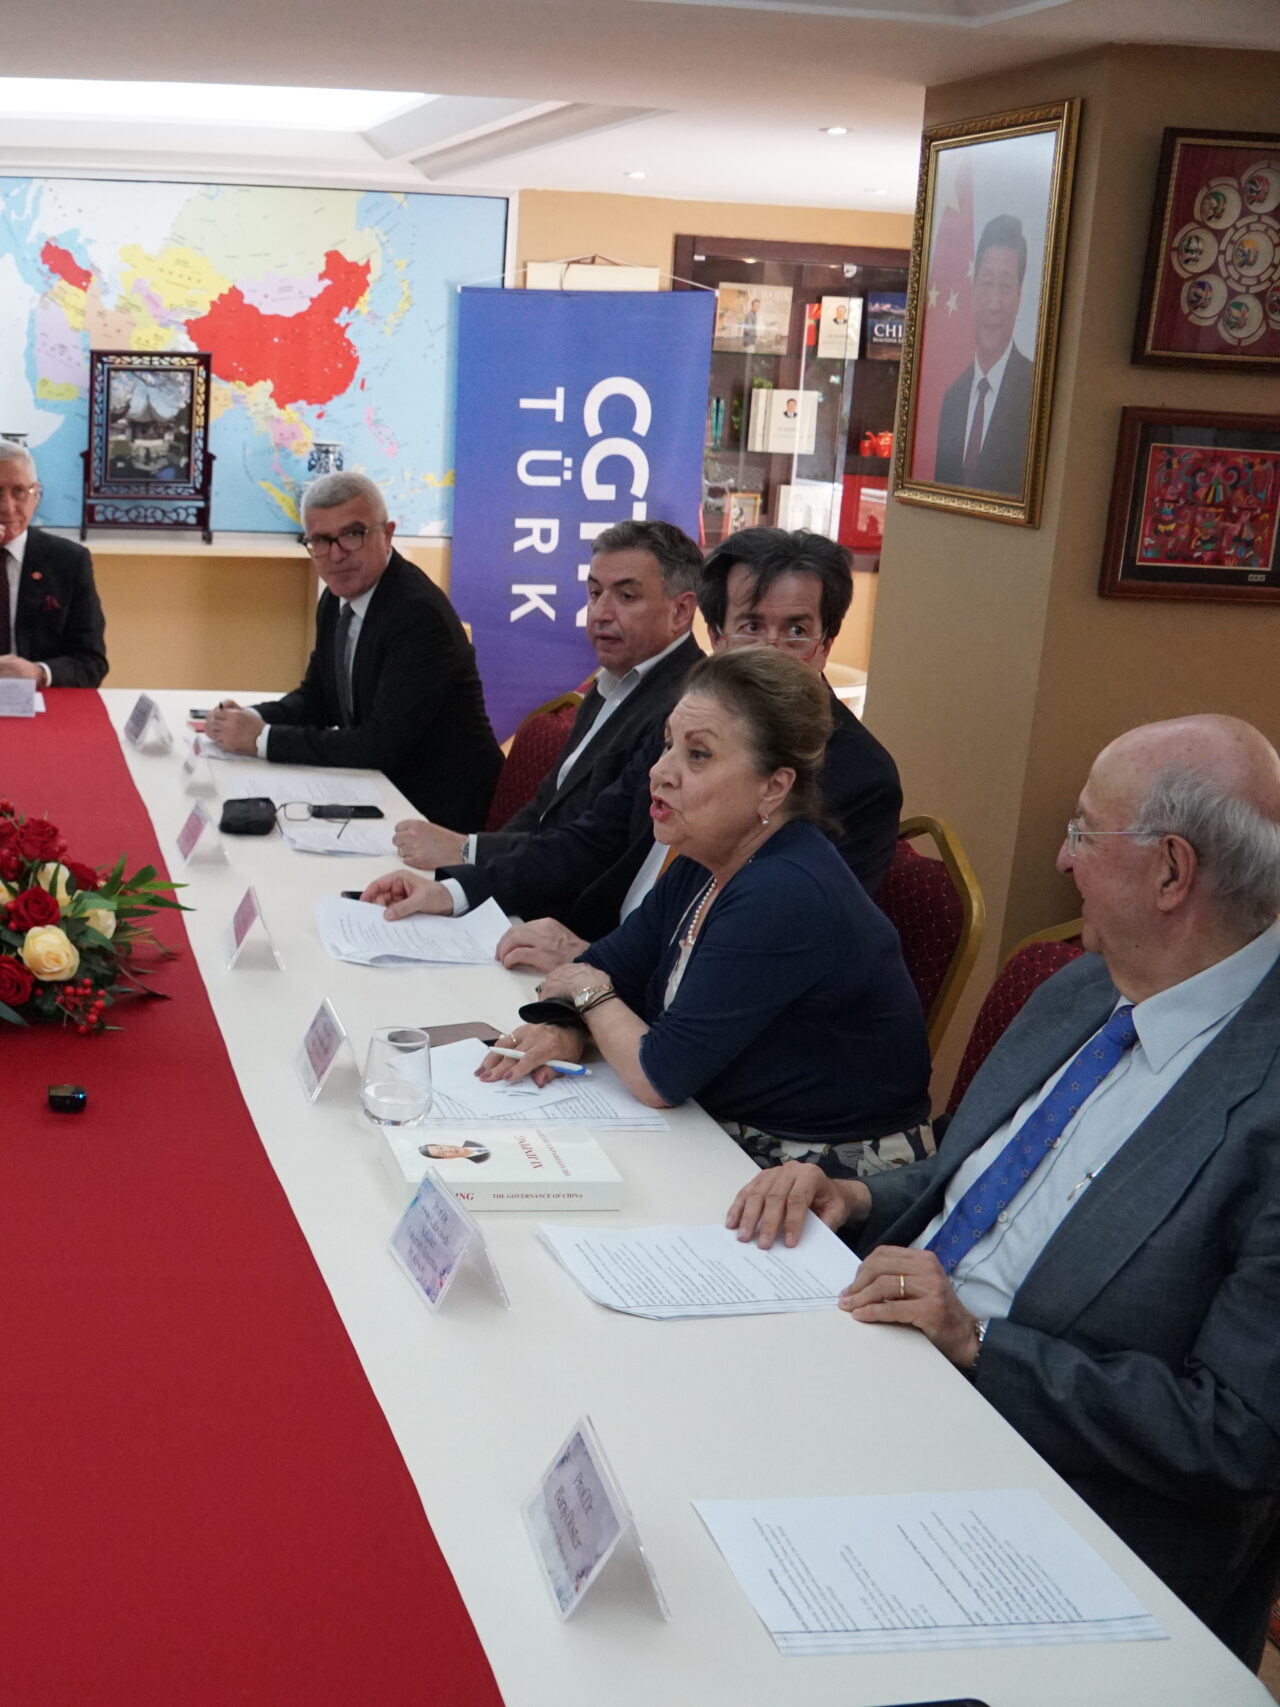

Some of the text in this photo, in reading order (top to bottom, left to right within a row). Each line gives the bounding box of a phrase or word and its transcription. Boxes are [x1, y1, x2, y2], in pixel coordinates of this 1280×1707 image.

[874, 324, 902, 338] CHI
[509, 386, 573, 623] TÜRK
[576, 376, 652, 628] CG
